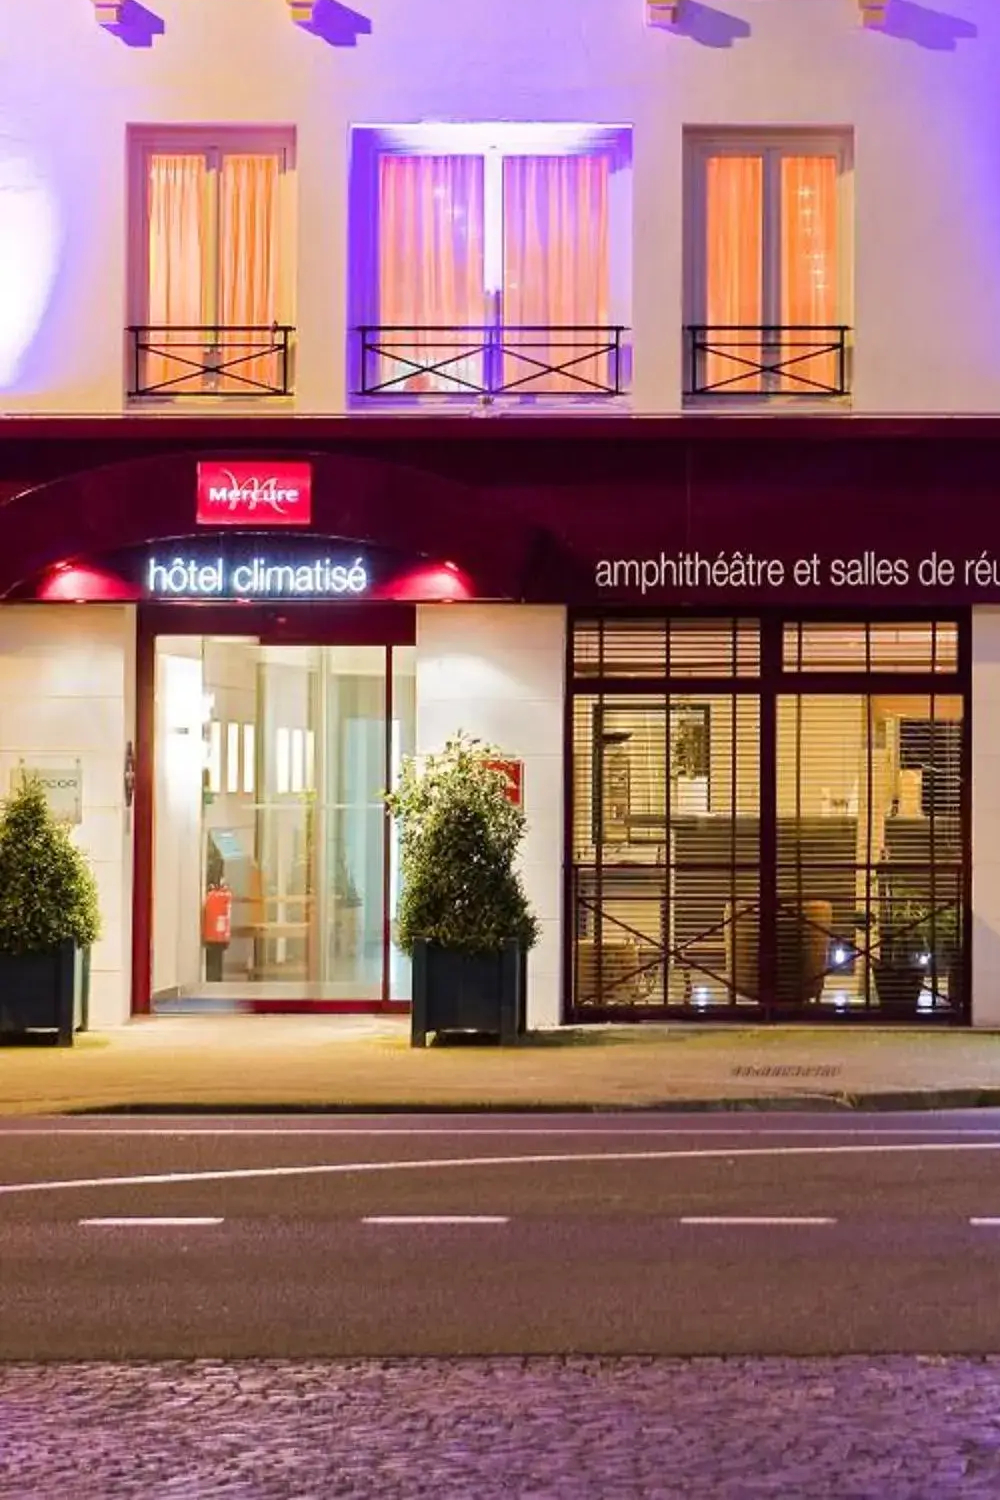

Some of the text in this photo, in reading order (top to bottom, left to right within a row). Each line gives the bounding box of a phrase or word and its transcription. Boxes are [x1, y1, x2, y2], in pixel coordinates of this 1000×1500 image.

[208, 486, 299, 503] Mercure
[148, 557, 367, 592] hôtel climatisé
[595, 551, 785, 595] amphithéâtre
[793, 553, 821, 587] et
[830, 551, 910, 587] salles
[918, 551, 955, 587] de
